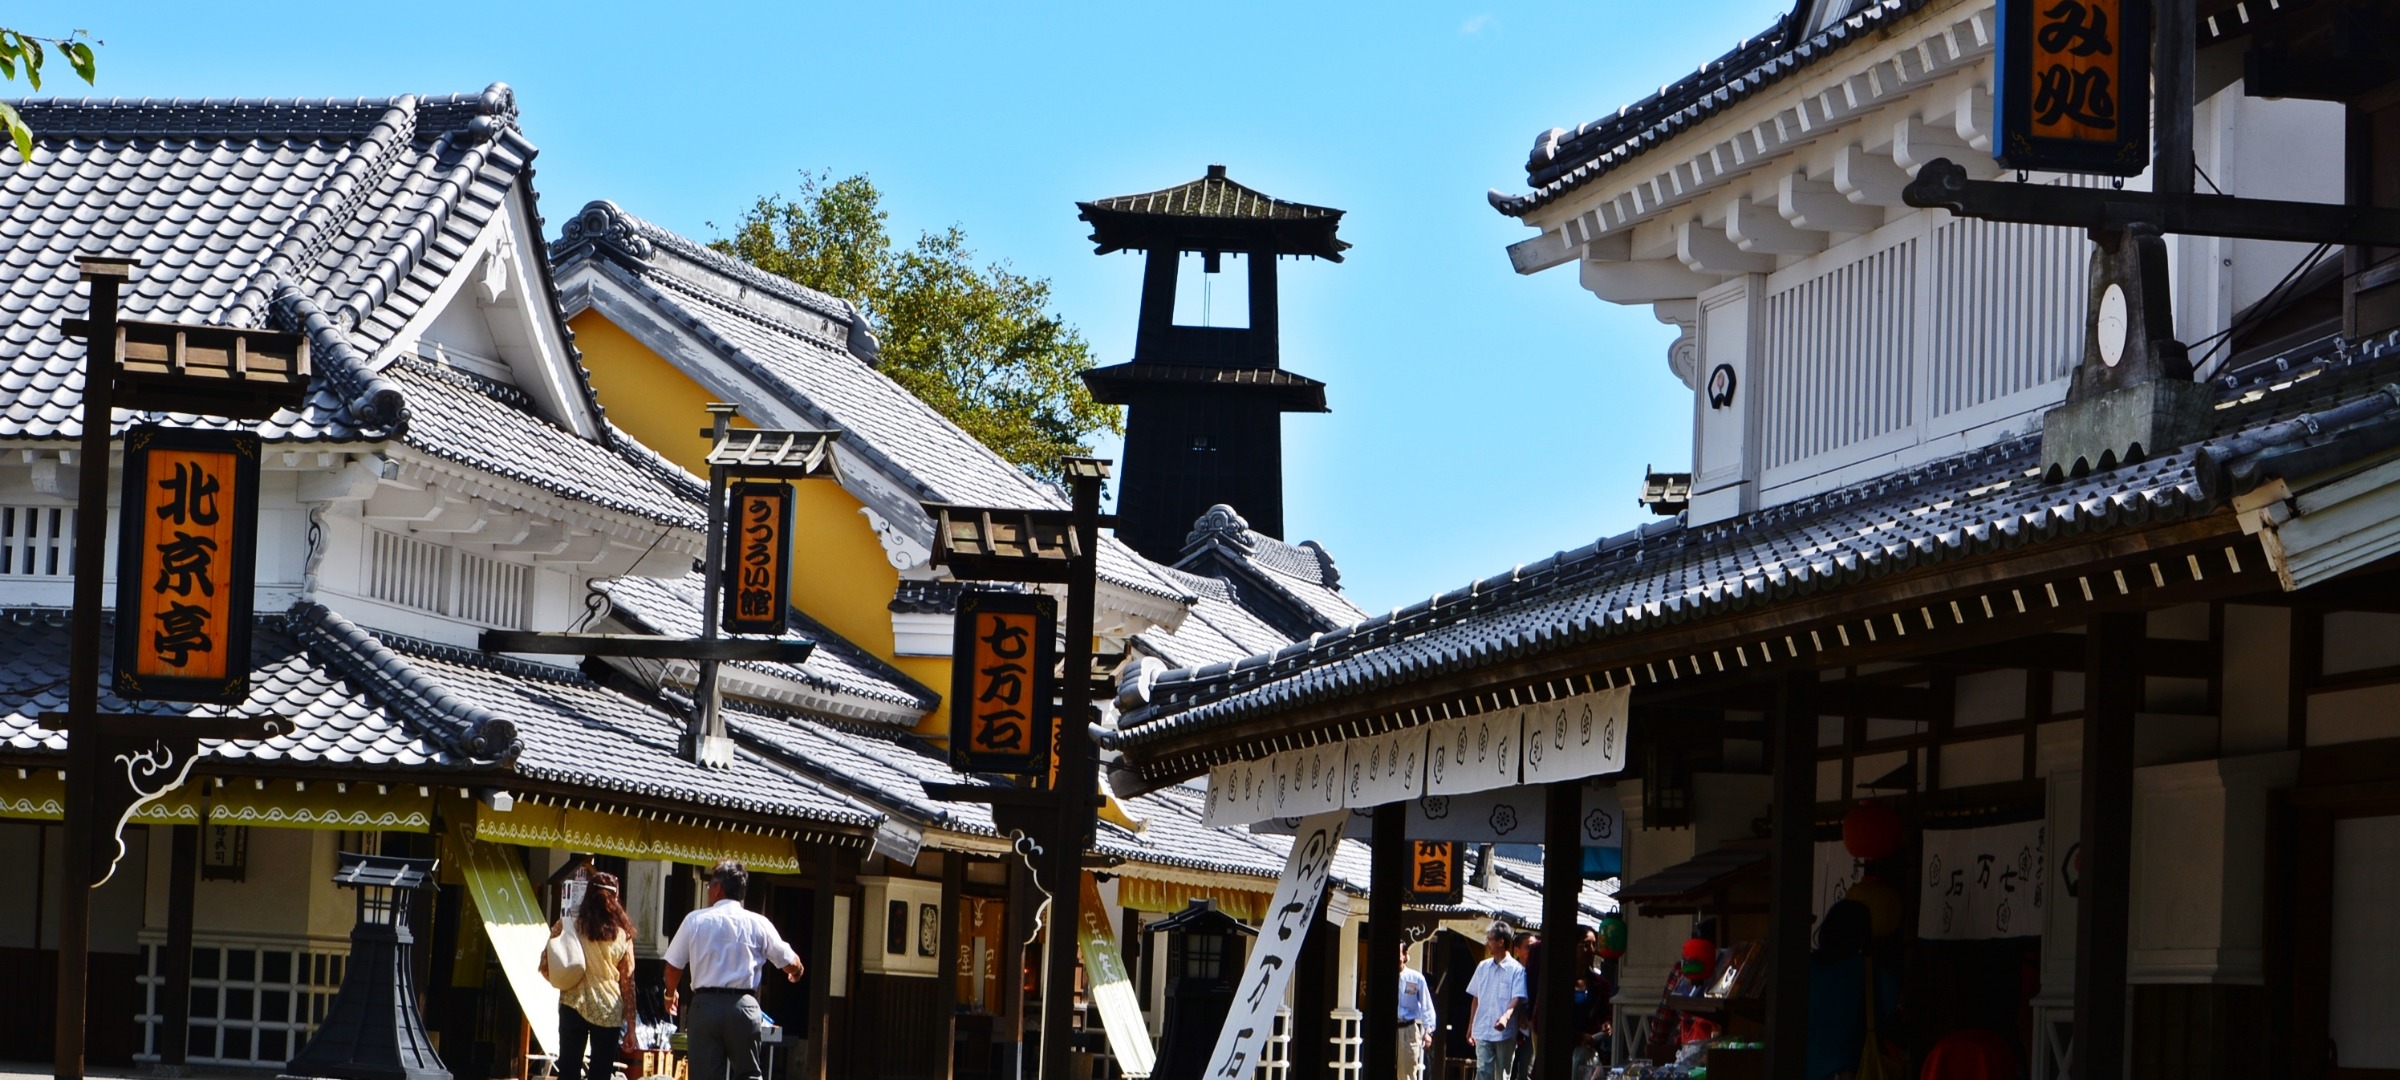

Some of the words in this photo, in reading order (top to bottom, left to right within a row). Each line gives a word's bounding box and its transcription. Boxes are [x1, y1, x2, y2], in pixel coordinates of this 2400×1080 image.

[153, 461, 220, 667] 北京亭
[740, 500, 773, 616] うつろい館
[976, 616, 1029, 750] 七万石
[1218, 889, 1304, 1079] 七万石
